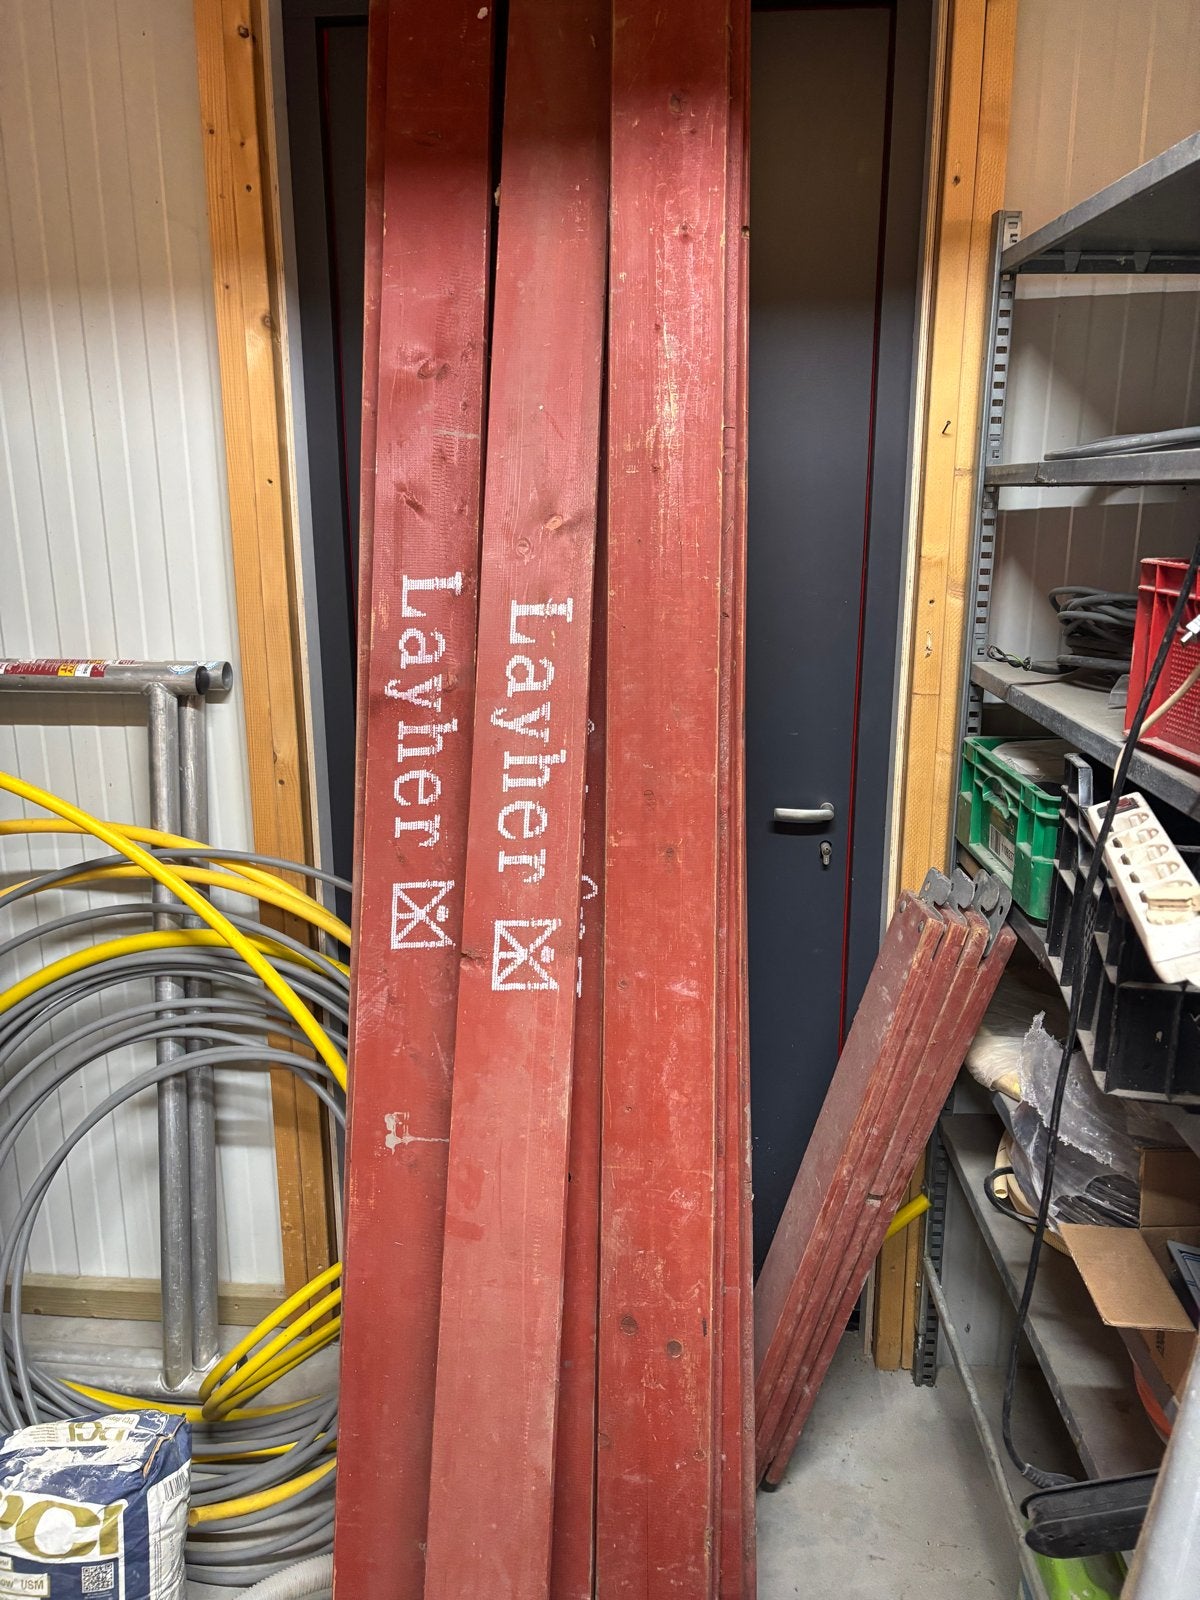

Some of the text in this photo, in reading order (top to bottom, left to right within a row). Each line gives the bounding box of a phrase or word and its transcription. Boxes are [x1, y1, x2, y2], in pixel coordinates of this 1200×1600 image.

[385, 572, 463, 849] Layher
[490, 597, 574, 884] Layher
[67, 1421, 125, 1442] PCI
[20, 1579, 44, 1591] USM
